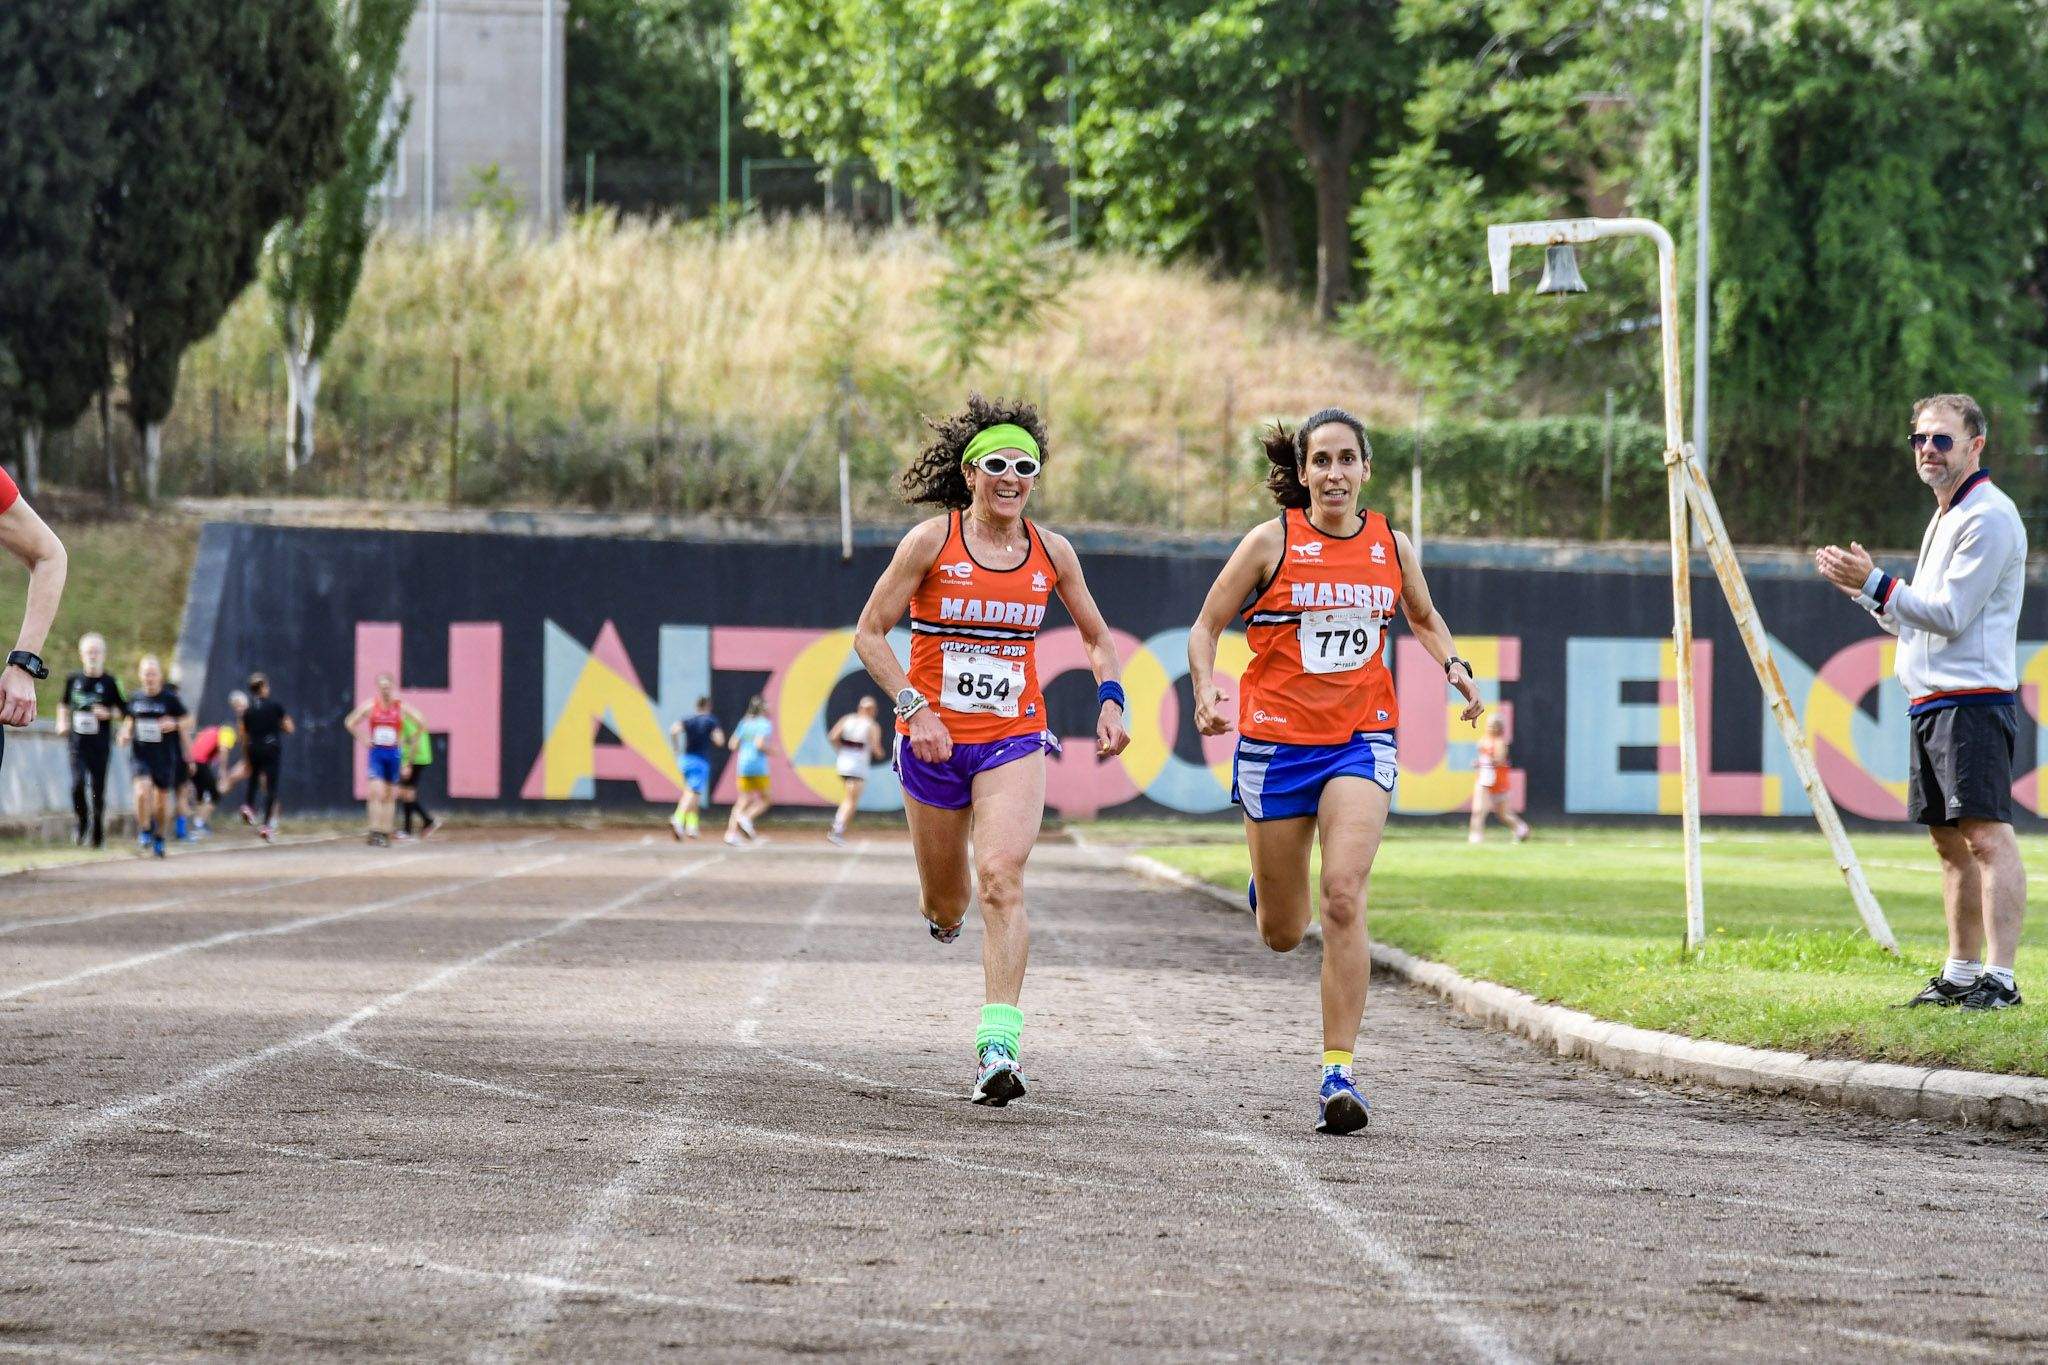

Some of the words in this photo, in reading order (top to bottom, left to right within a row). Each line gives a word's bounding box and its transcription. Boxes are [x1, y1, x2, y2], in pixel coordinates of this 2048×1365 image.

[940, 597, 1045, 627] MADRID
[1291, 583, 1394, 612] MADRID
[1315, 628, 1369, 658] 779
[957, 672, 1010, 701] 854
